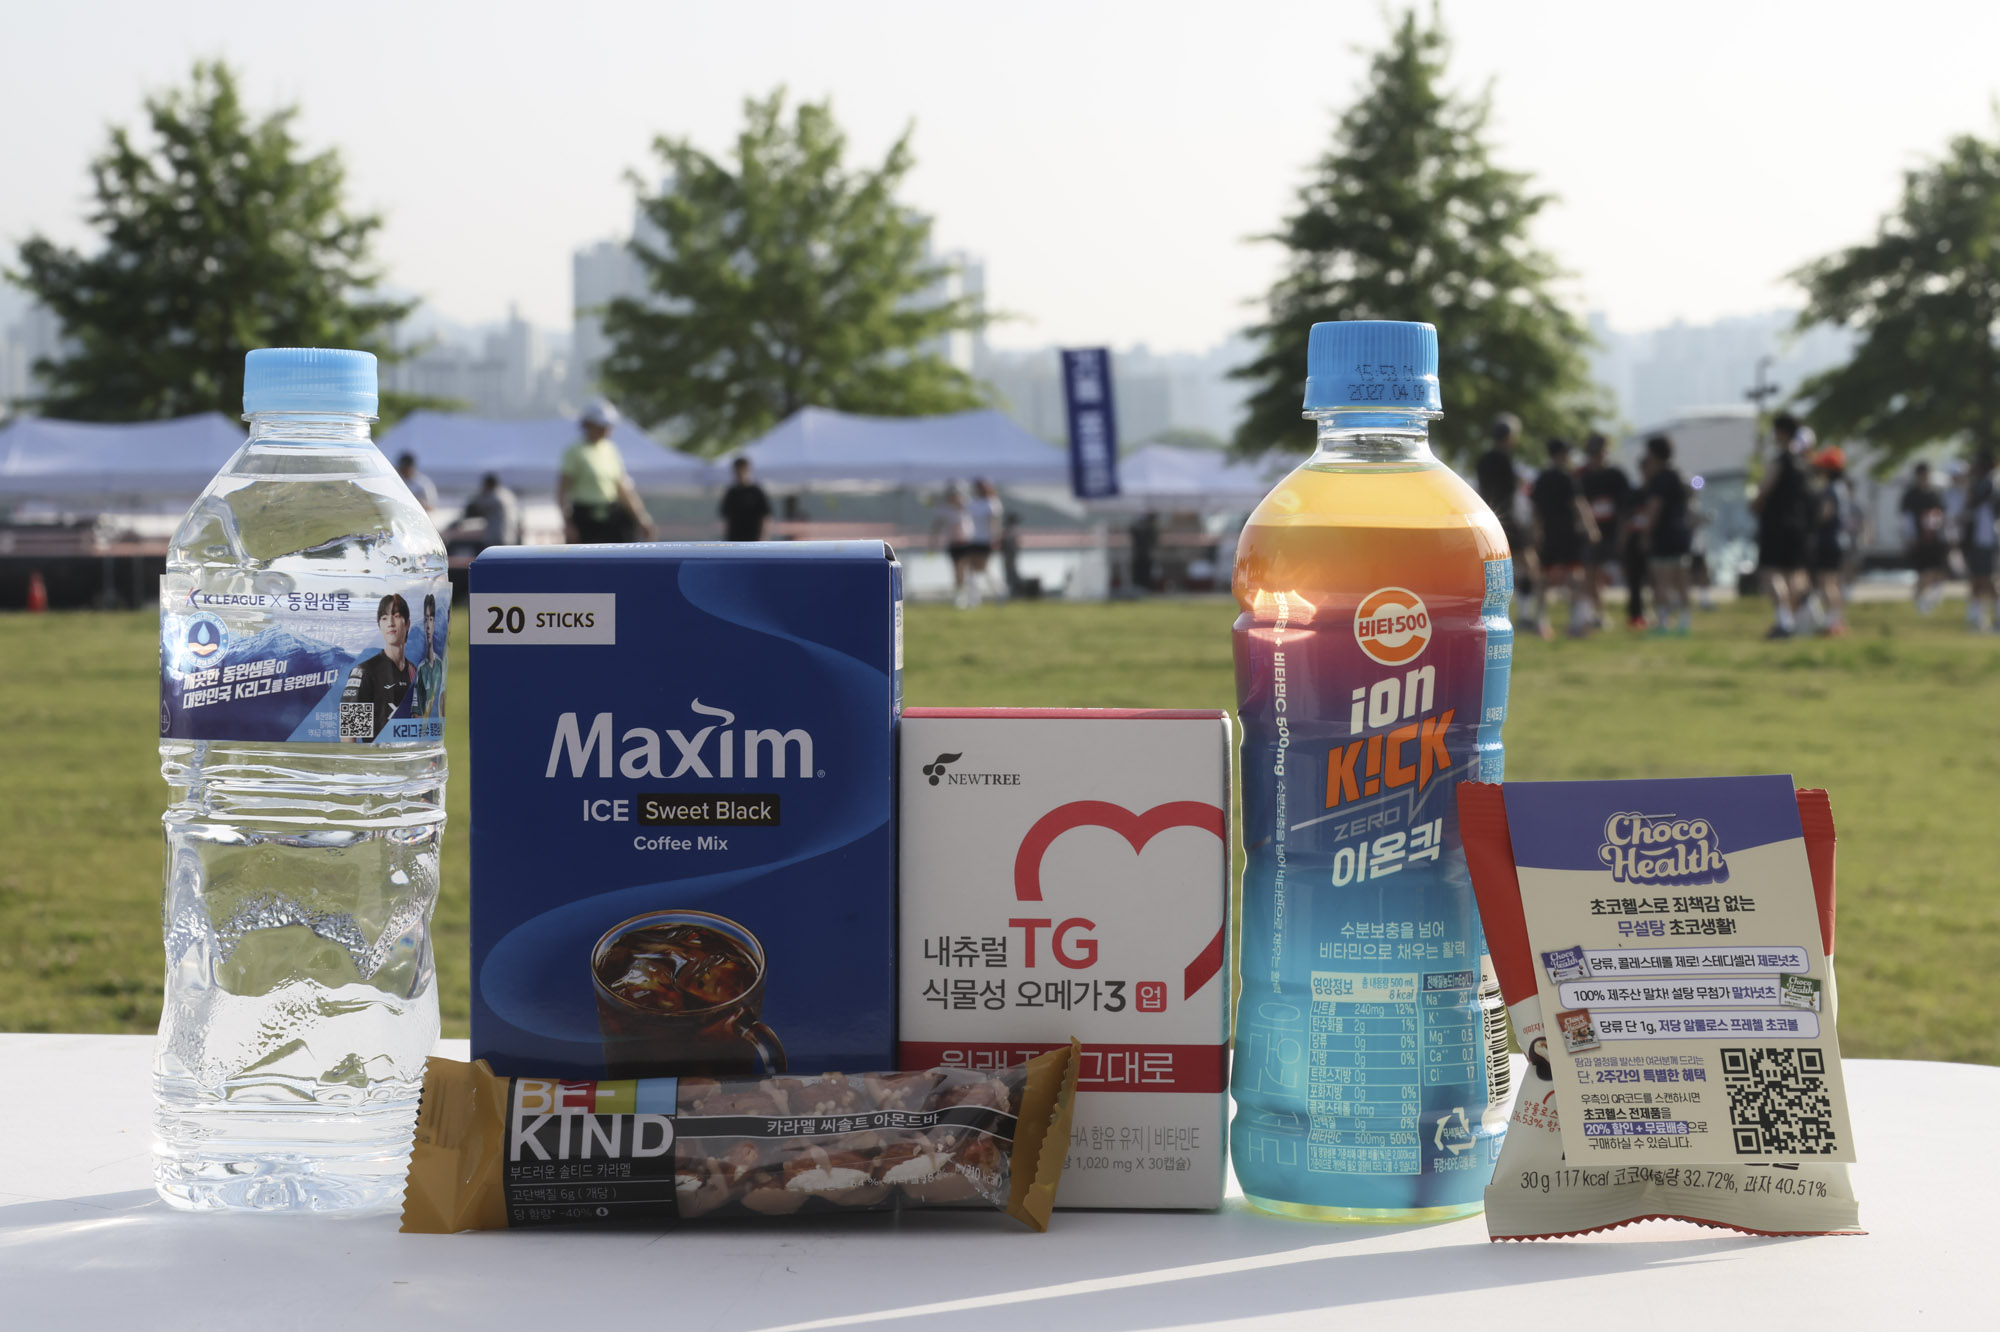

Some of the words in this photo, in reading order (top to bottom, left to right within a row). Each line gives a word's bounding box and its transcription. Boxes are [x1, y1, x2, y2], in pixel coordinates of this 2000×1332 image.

[203, 594, 213, 605] K
[216, 596, 265, 606] LEAGUE
[288, 592, 351, 611] 동원샘물
[487, 606, 526, 634] 20
[536, 612, 595, 628] STICKS
[1359, 612, 1427, 638] 비타500
[222, 658, 288, 684] 동원샘물이
[182, 684, 232, 709] 대한민국
[234, 678, 283, 699] K리그를
[284, 669, 339, 691] 응원합니다
[1274, 652, 1287, 713] 비타민C
[1350, 665, 1436, 736] ion
[394, 724, 417, 737] K리그
[545, 697, 813, 779] Maxim
[1274, 716, 1290, 776] 500mg
[948, 774, 1021, 785] NEWTREE
[583, 799, 629, 822] ICE
[645, 801, 709, 821] Sweet
[716, 801, 772, 821] Black
[1334, 806, 1400, 843] ZERO
[1608, 814, 1708, 846] Choco
[633, 836, 692, 851] Coffee
[697, 837, 728, 851] Mix
[1331, 817, 1442, 888] 이온킥
[1601, 840, 1724, 878] Health
[1590, 898, 1670, 915] 초코헬스로
[1672, 896, 1720, 913] 죄책감
[1723, 895, 1755, 912] 없는
[1340, 921, 1414, 939] 수분보충을
[1418, 921, 1444, 938] 넘어
[1618, 920, 1665, 937] 무설탕
[1670, 918, 1736, 936] 초코생활!
[1009, 917, 1098, 969] TG
[1319, 942, 1392, 960] 비타민으로
[1397, 942, 1439, 960] 채우는
[1442, 941, 1465, 958] 활력
[924, 936, 1007, 968] 내츄럴
[1591, 958, 1617, 970] 당류,
[1618, 956, 1673, 970] 콜레스테롤
[1674, 956, 1700, 968] 제로!
[1702, 954, 1756, 967] 스테디셀러
[1757, 954, 1800, 967] 제로넛츠
[922, 978, 1006, 1010] 식물성
[1016, 980, 1126, 1012] 오메가3
[1141, 986, 1160, 1009] 업
[1313, 977, 1354, 996] 영양정보
[1389, 989, 1395, 1000] 8
[1396, 989, 1414, 1000] kcal
[1574, 990, 1605, 1001] 100%
[1607, 988, 1641, 1001] 제주산
[1643, 988, 1670, 1000] 말차!
[1671, 987, 1694, 1000] 설탕
[1696, 986, 1730, 999] 무첨가
[1732, 986, 1776, 999] 말차넛츠
[1313, 1002, 1336, 1016] 나트륨
[1354, 1004, 1384, 1018] 240mg
[1395, 1004, 1414, 1015] 12%
[1312, 1017, 1343, 1032] 탄수화물
[1354, 1019, 1365, 1035] 2g
[1401, 1019, 1415, 1031] 1%
[1600, 1020, 1624, 1033] 당류
[1626, 1020, 1637, 1032] 단
[1640, 1021, 1657, 1035] 1g,
[1659, 1020, 1681, 1032] 저당
[1684, 1019, 1728, 1032] 알룰로스
[1730, 1018, 1764, 1031] 프레첼
[1766, 1018, 1799, 1031] 초코볼
[1312, 1034, 1328, 1049] 당류
[1354, 1036, 1366, 1051] 0g
[1400, 1036, 1415, 1048] 0%
[1461, 1029, 1473, 1042] 0.5
[1311, 1051, 1327, 1065] 지방
[1354, 1053, 1366, 1067] 0g
[1400, 1053, 1415, 1065] 0%
[1462, 1048, 1473, 1061] 0.7
[1645, 1056, 1678, 1066] 여러분께
[1680, 1055, 1704, 1066] 드리는
[1311, 1068, 1351, 1084] 트랜스지방
[1354, 1070, 1366, 1085] 0g
[1466, 1066, 1474, 1079] 17
[1577, 1070, 1594, 1084] 단,
[1596, 1069, 1640, 1083] 2주간의
[1643, 1068, 1679, 1083] 특별한
[1682, 1068, 1707, 1082] 혜택
[1310, 1085, 1342, 1100] 포화지방
[1354, 1087, 1366, 1102] 0g
[1402, 1086, 1416, 1099] 0%
[1581, 1094, 1609, 1105] 우측의
[1611, 1093, 1652, 1104] QR코드를
[1654, 1092, 1701, 1103] 스캔하시면
[1310, 1102, 1351, 1117] 콜레스테롤
[1354, 1103, 1374, 1117] 0mg
[1402, 1103, 1416, 1116] 0%
[1584, 1108, 1627, 1120] 초코헬스
[1629, 1107, 1672, 1120] 전제품을
[767, 1117, 816, 1135] 카라멜
[820, 1115, 870, 1133] 씨솔트
[873, 1112, 939, 1128] 아몬드바
[1312, 1117, 1336, 1129] 단백질
[1354, 1118, 1366, 1132] 0g
[1400, 1118, 1414, 1129] 0%
[1585, 1124, 1610, 1135] 20%
[1612, 1123, 1634, 1135] 할인
[1644, 1121, 1708, 1134] 무료배송으로
[510, 1114, 674, 1162] KIND
[1092, 1127, 1116, 1151] 함유
[1120, 1126, 1143, 1150] 유지
[1154, 1126, 1200, 1152] 비타민E
[1311, 1131, 1342, 1144] 비타민C
[1354, 1134, 1385, 1147] 500mg
[1390, 1133, 1416, 1145] 500%
[1588, 1138, 1631, 1150] 구매하실
[1634, 1138, 1645, 1149] 수
[1647, 1137, 1693, 1149] 있습니다.
[510, 1165, 555, 1180] 부드러운
[559, 1164, 593, 1179] 솔티드
[597, 1163, 631, 1178] 카라멜
[1076, 1157, 1108, 1171] 1,020
[1113, 1160, 1132, 1173] mg
[1148, 1156, 1191, 1171] 30캡슐)
[1683, 1169, 1738, 1194] 32.72%,
[1744, 1175, 1772, 1193] 과자
[1775, 1178, 1827, 1198] 40.51%
[512, 1188, 557, 1201] 고단백질
[561, 1189, 575, 1201] 6g
